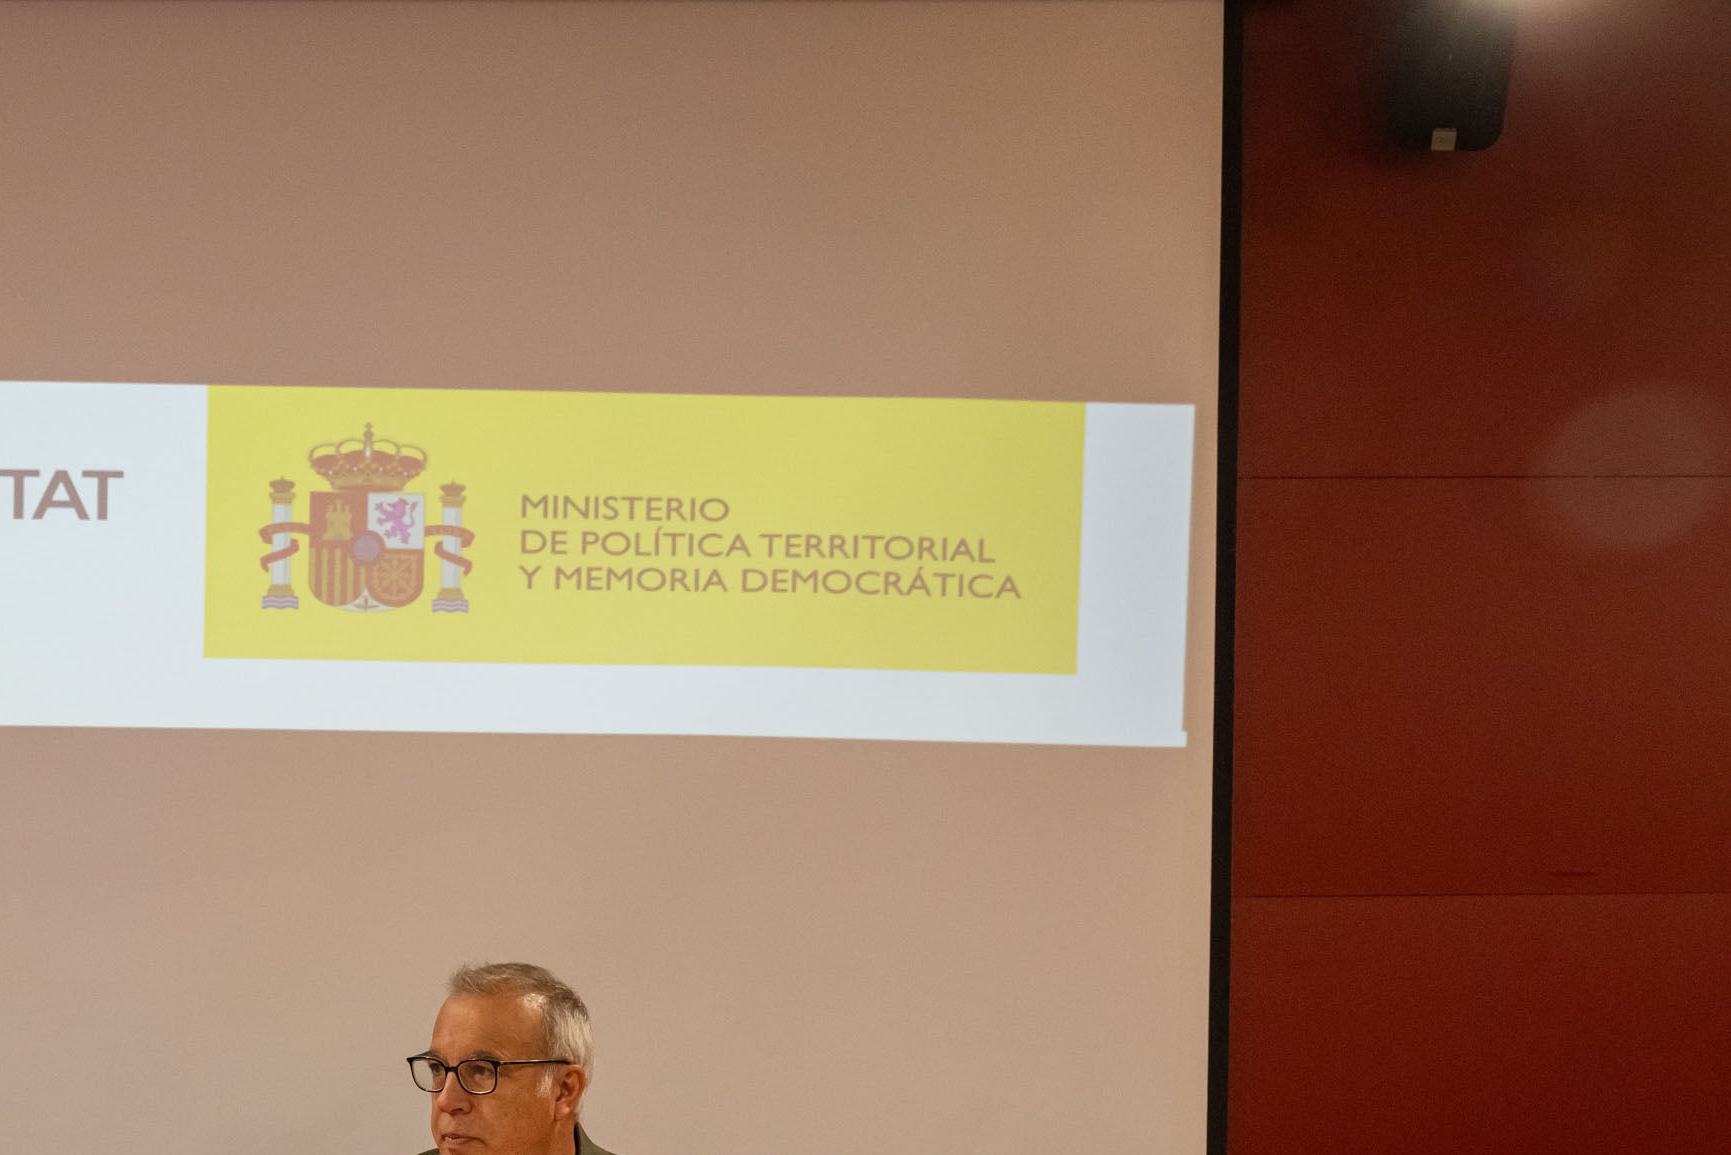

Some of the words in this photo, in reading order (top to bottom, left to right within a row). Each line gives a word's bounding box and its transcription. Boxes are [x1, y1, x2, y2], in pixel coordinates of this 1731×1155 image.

[520, 494, 731, 523] MINISTERIO
[520, 529, 569, 555] DE
[581, 525, 753, 558] POLÍTICA
[759, 533, 998, 564] TERRITORIAL
[518, 565, 542, 590] Y
[554, 565, 729, 593] MEMORIA
[741, 566, 1023, 600] DEMOCRÁTICA
